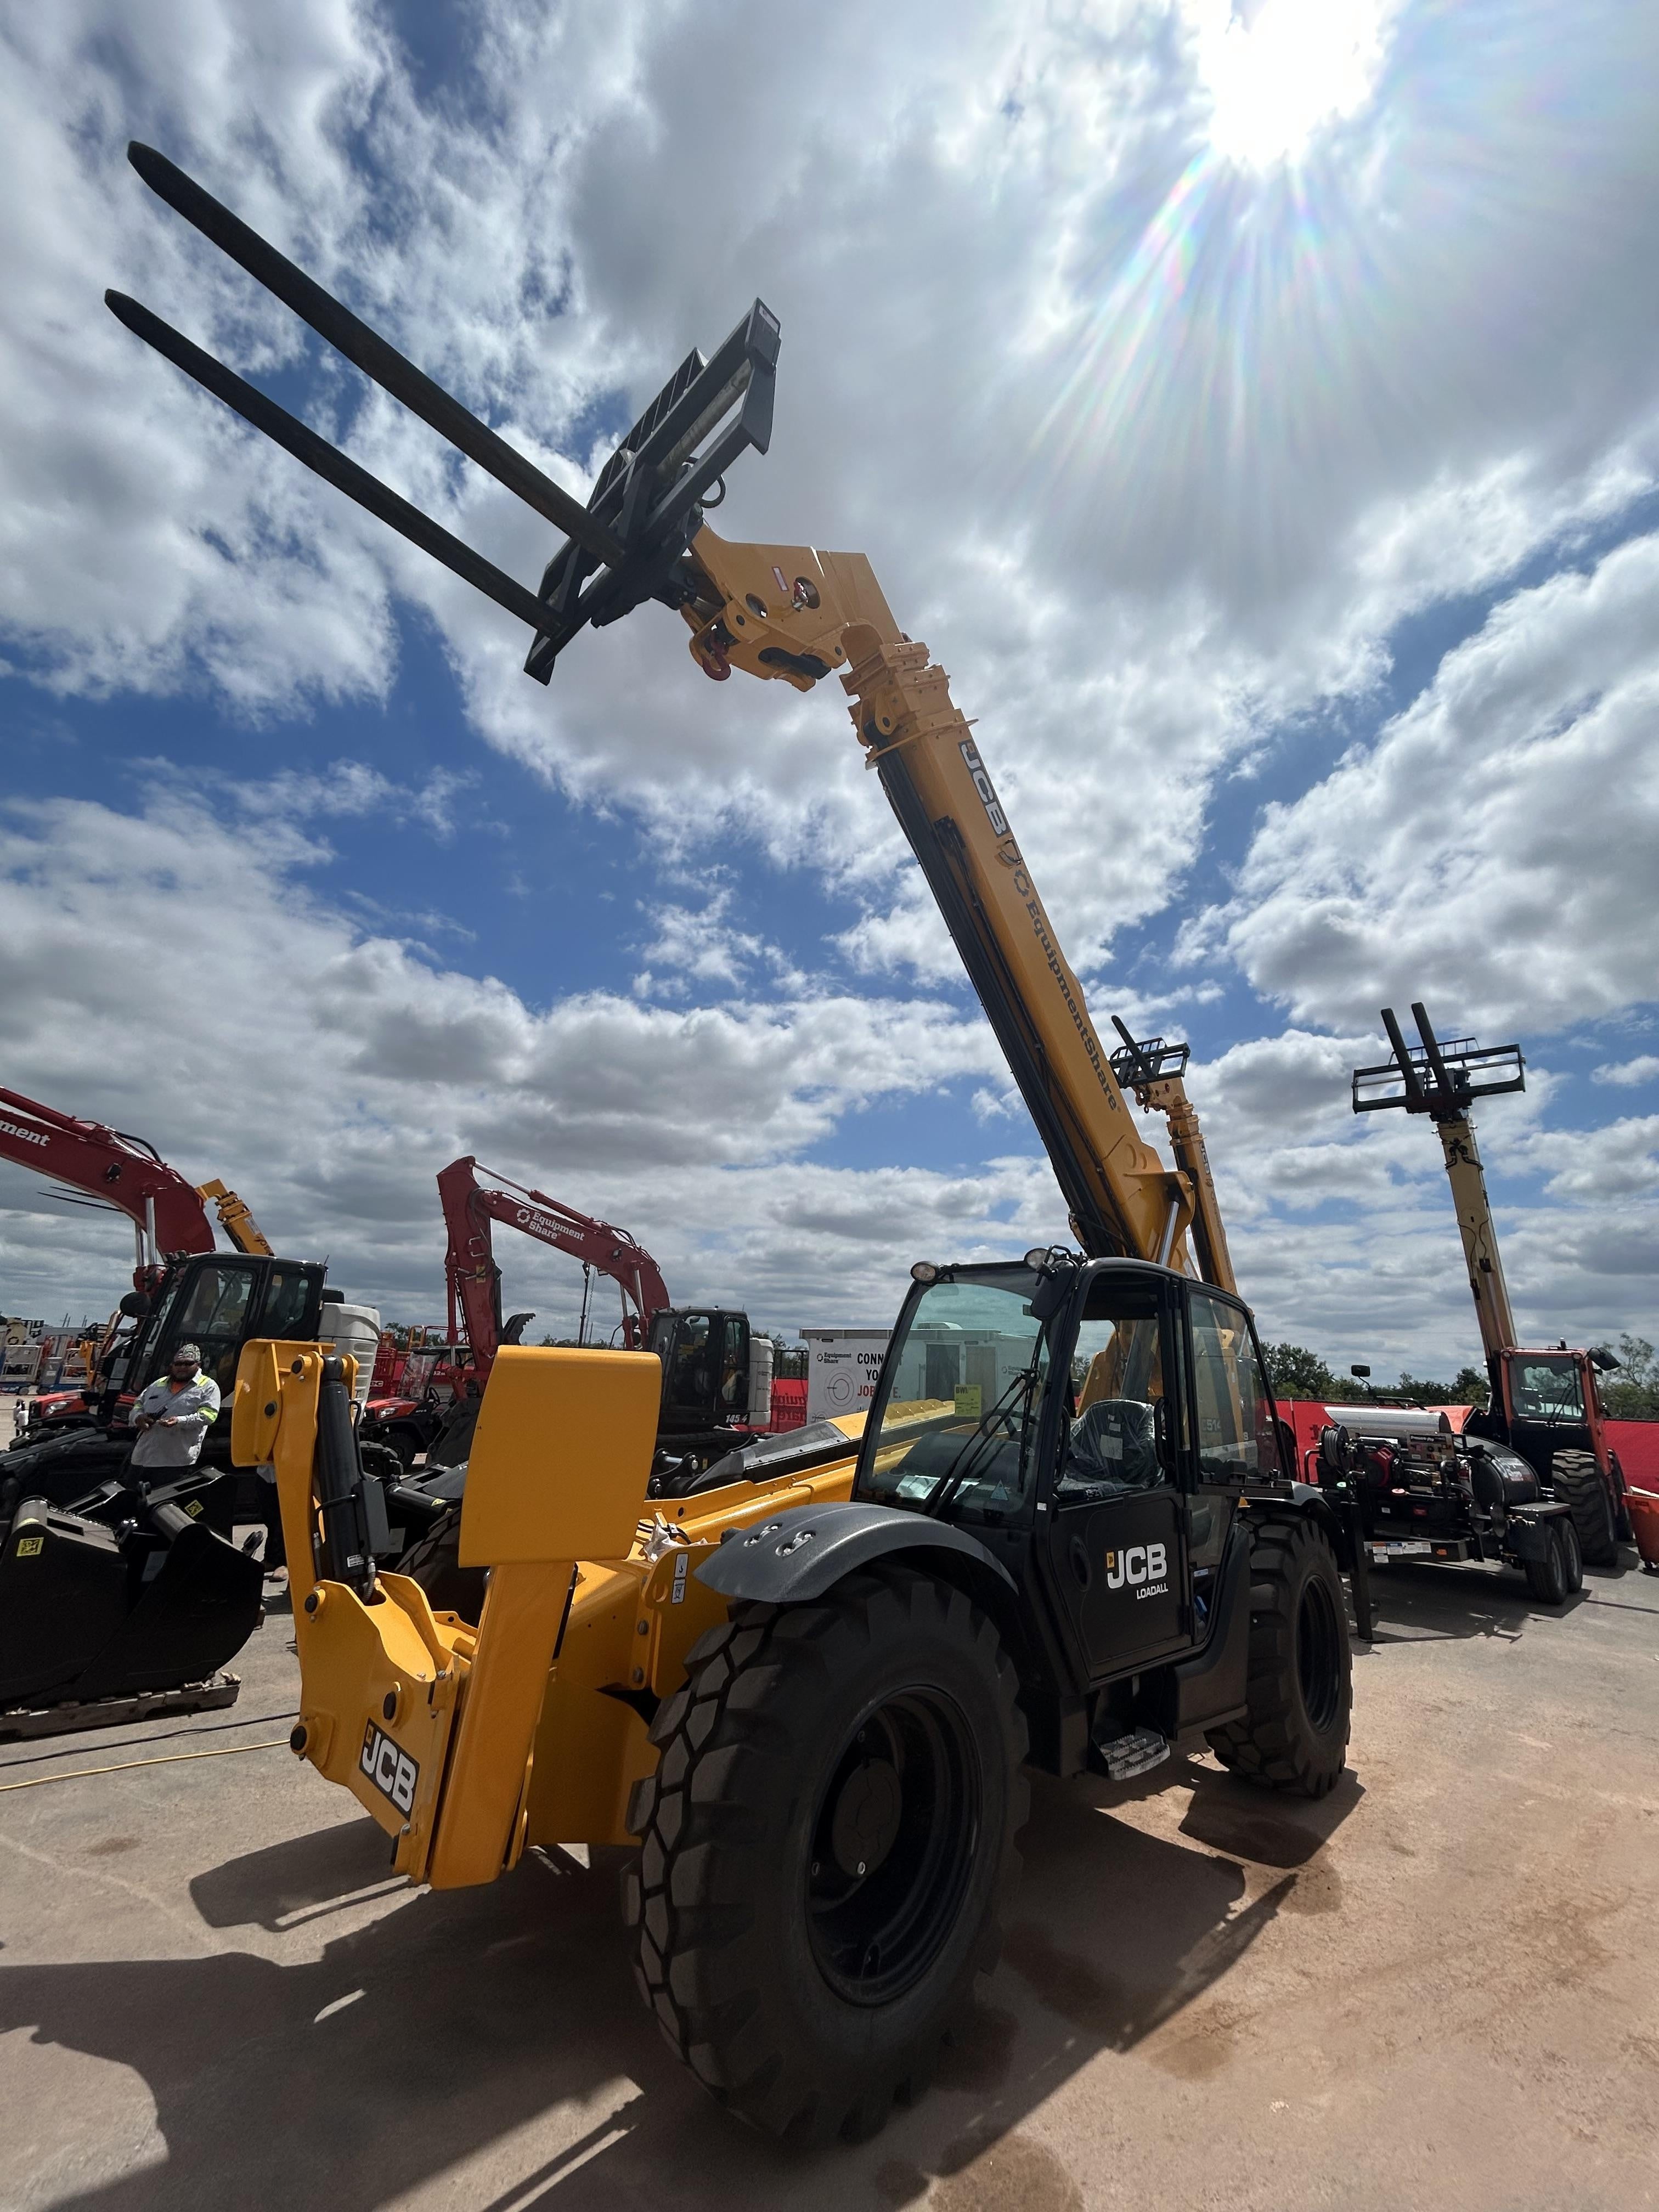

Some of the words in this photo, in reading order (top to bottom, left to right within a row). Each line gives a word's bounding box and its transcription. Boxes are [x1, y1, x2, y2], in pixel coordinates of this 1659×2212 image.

[961, 744, 1007, 834] JCB
[1026, 899, 1118, 1112] EquipmentShare
[529, 1221, 558, 1239] Share
[532, 1211, 585, 1240] Equipment
[1107, 1543, 1167, 1589] JCB
[1136, 1582, 1169, 1600] LOADALL
[362, 1731, 416, 1812] JCB
